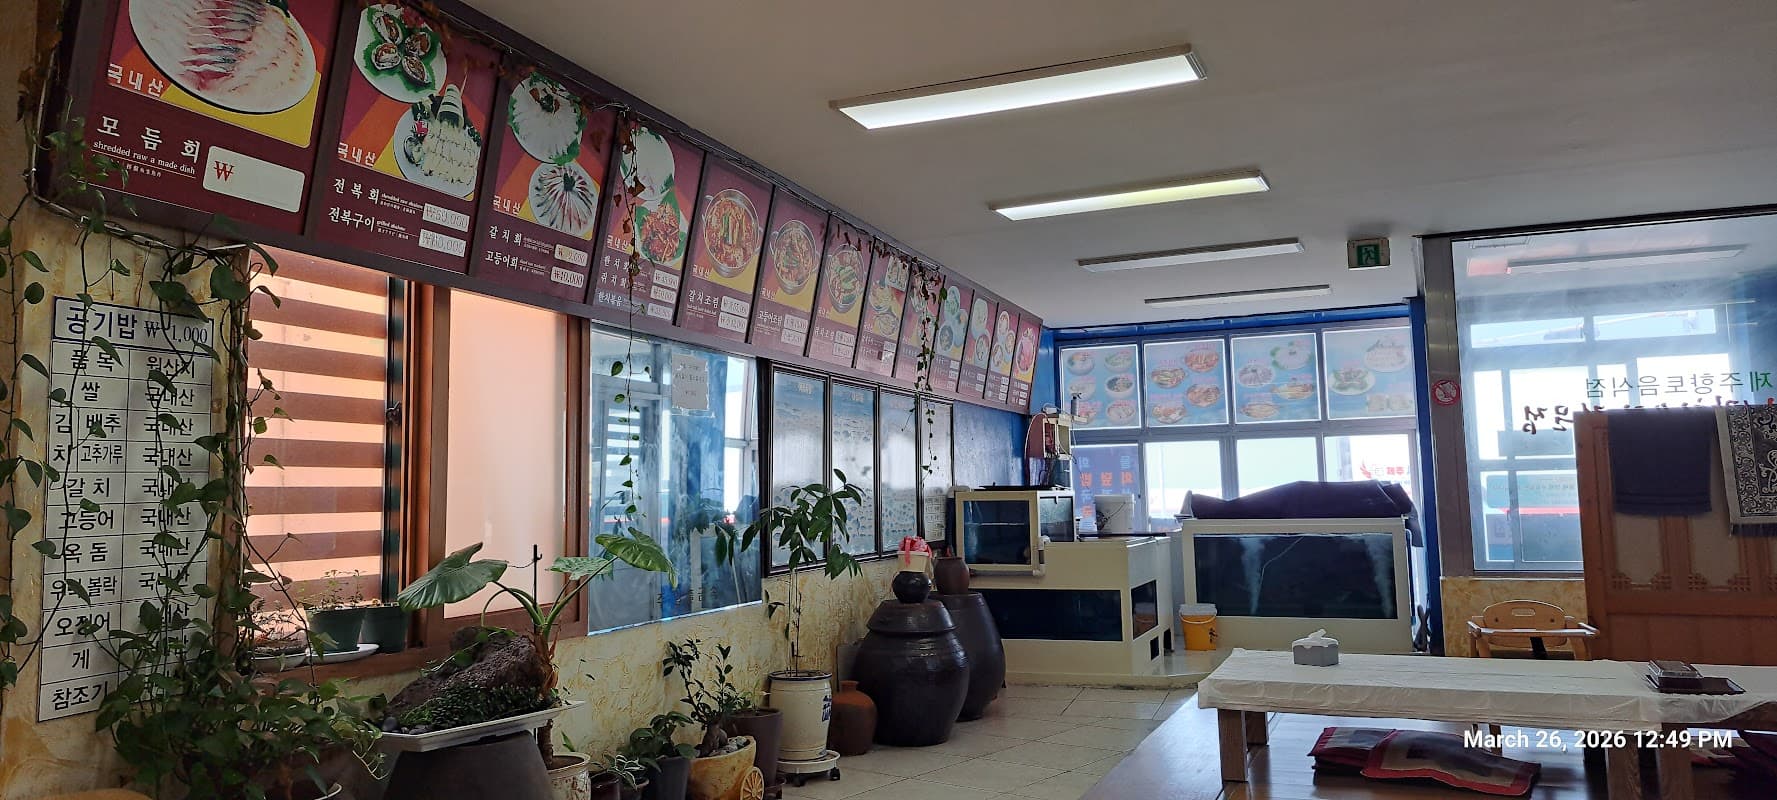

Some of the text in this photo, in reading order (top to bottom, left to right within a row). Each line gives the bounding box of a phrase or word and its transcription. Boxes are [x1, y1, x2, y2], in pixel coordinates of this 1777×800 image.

[107, 63, 163, 98] 국내산
[93, 141, 131, 156] shredded
[133, 152, 148, 161] raw
[158, 159, 178, 170] made
[338, 143, 376, 167] 국내산
[493, 195, 520, 215] 국내산
[328, 207, 375, 232] 전복구이
[688, 289, 719, 309] 갈치조림
[66, 306, 137, 340] 공기밥
[146, 356, 195, 379] 원산지
[81, 381, 100, 402] 쌀
[86, 413, 121, 434] 배추
[80, 443, 123, 465] 고추가루
[143, 447, 193, 467] 국내산
[142, 477, 190, 498] 국내
[58, 509, 114, 531] 고등어
[140, 506, 191, 527] 국내산
[55, 612, 110, 637] 오징어
[71, 648, 90, 670] 게
[52, 681, 108, 711] 참조기
